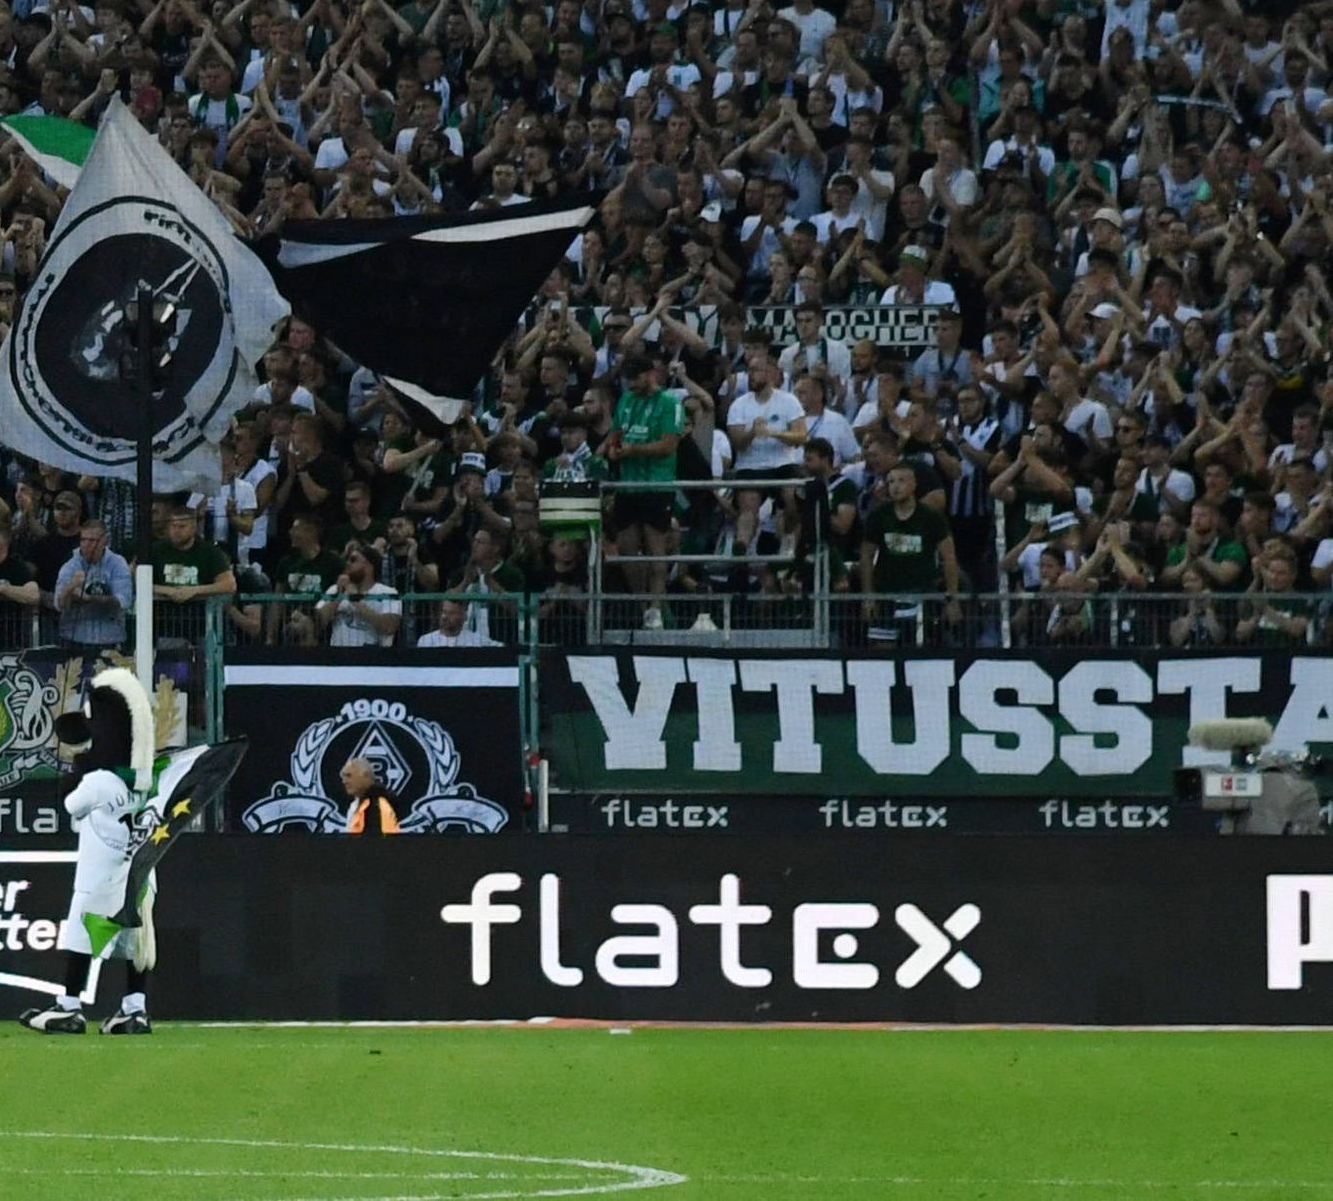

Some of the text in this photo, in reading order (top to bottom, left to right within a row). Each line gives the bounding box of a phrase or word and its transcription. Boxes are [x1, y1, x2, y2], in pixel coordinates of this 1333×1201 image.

[339, 698, 407, 723] 1900
[601, 800, 729, 829] flatex
[819, 800, 949, 829] flatex
[1038, 800, 1170, 829] flatex
[440, 872, 982, 991] flatex
